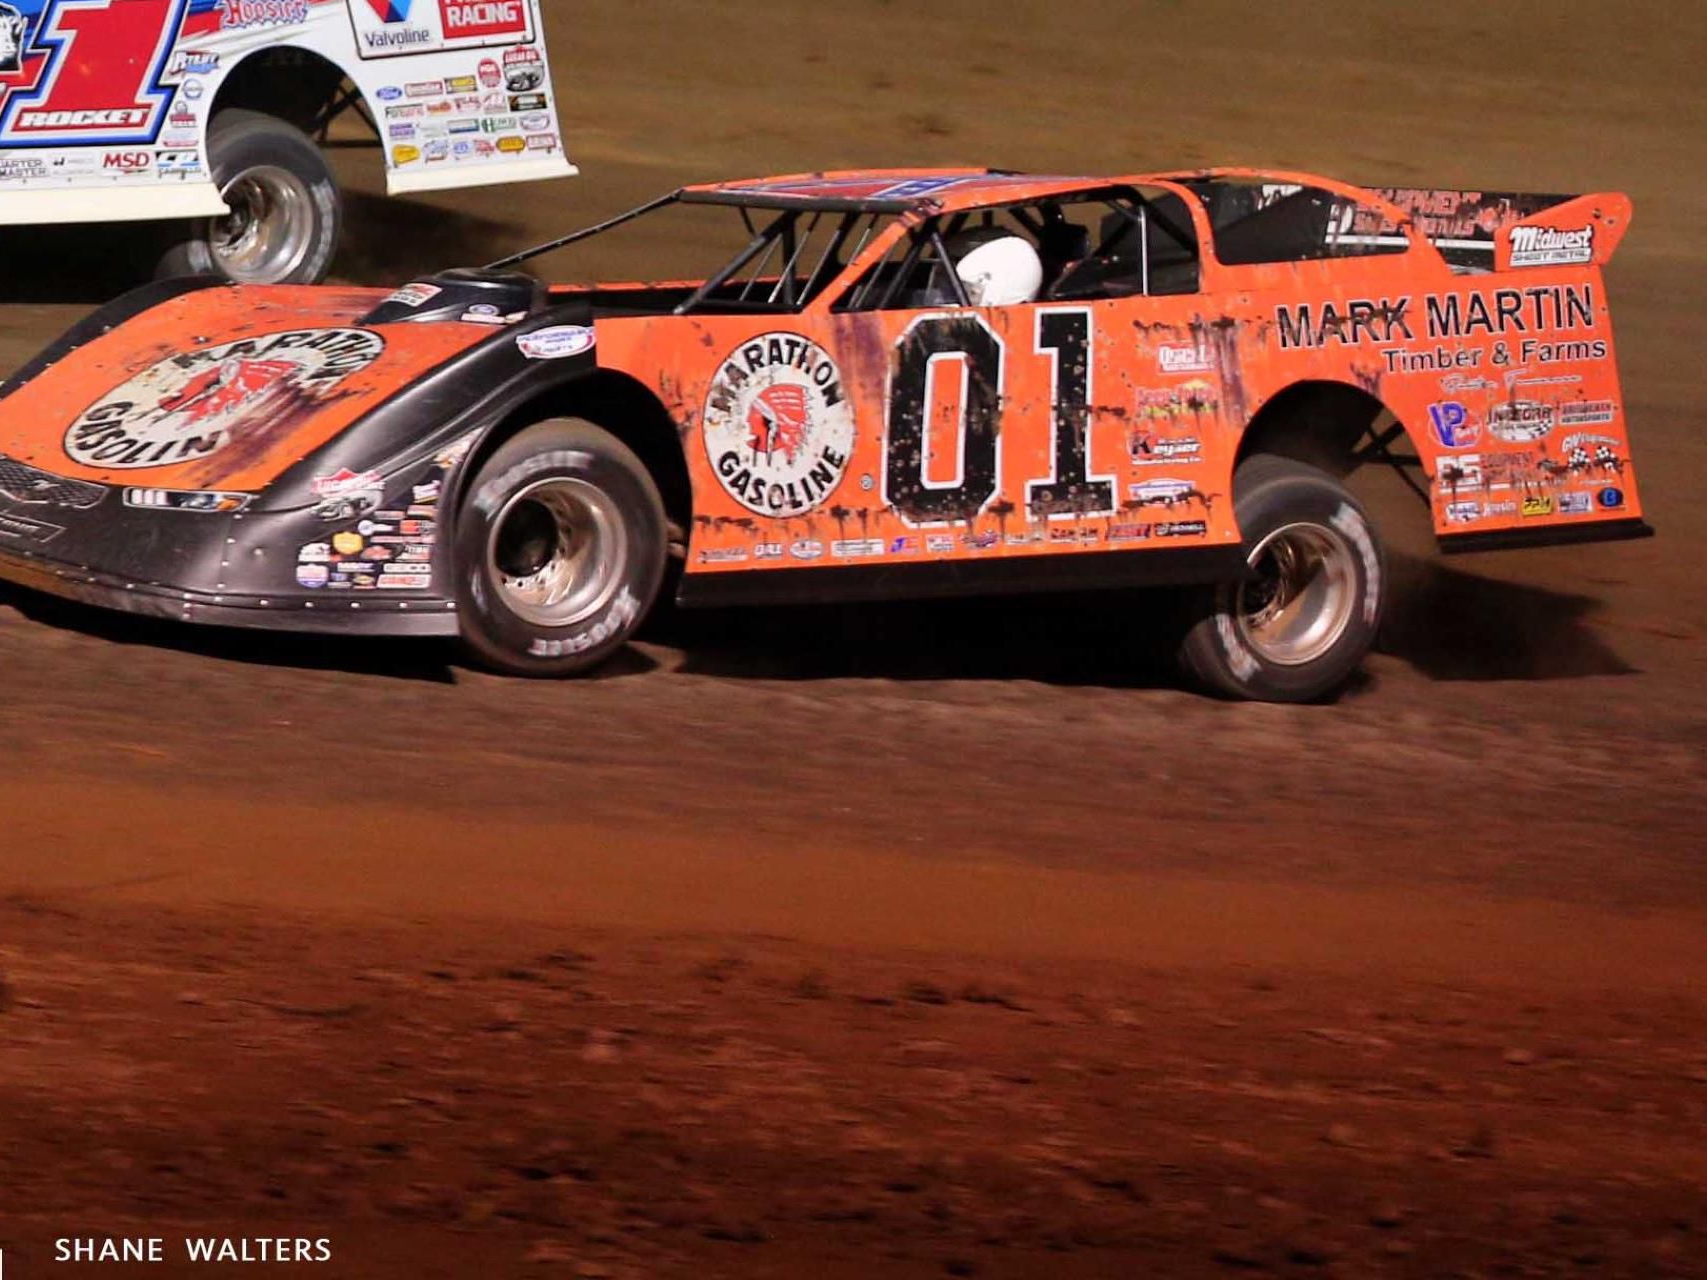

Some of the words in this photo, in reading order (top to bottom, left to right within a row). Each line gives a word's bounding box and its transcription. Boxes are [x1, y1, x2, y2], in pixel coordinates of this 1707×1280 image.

[447, 0, 515, 29] RACING
[364, 27, 431, 49] Valvoline
[19, 108, 151, 127] ROCKET
[102, 152, 150, 169] MSD
[1510, 225, 1592, 252] Midwest
[1275, 296, 1412, 350] MARK
[1427, 284, 1593, 338] MARTIN
[1382, 345, 1482, 375] Timber
[1492, 342, 1511, 365] &
[1520, 338, 1607, 365] Farms
[710, 335, 843, 416] MARATHON
[74, 400, 225, 464] GASOLIN
[881, 305, 1118, 528] 01
[717, 446, 846, 510] GASOLINE
